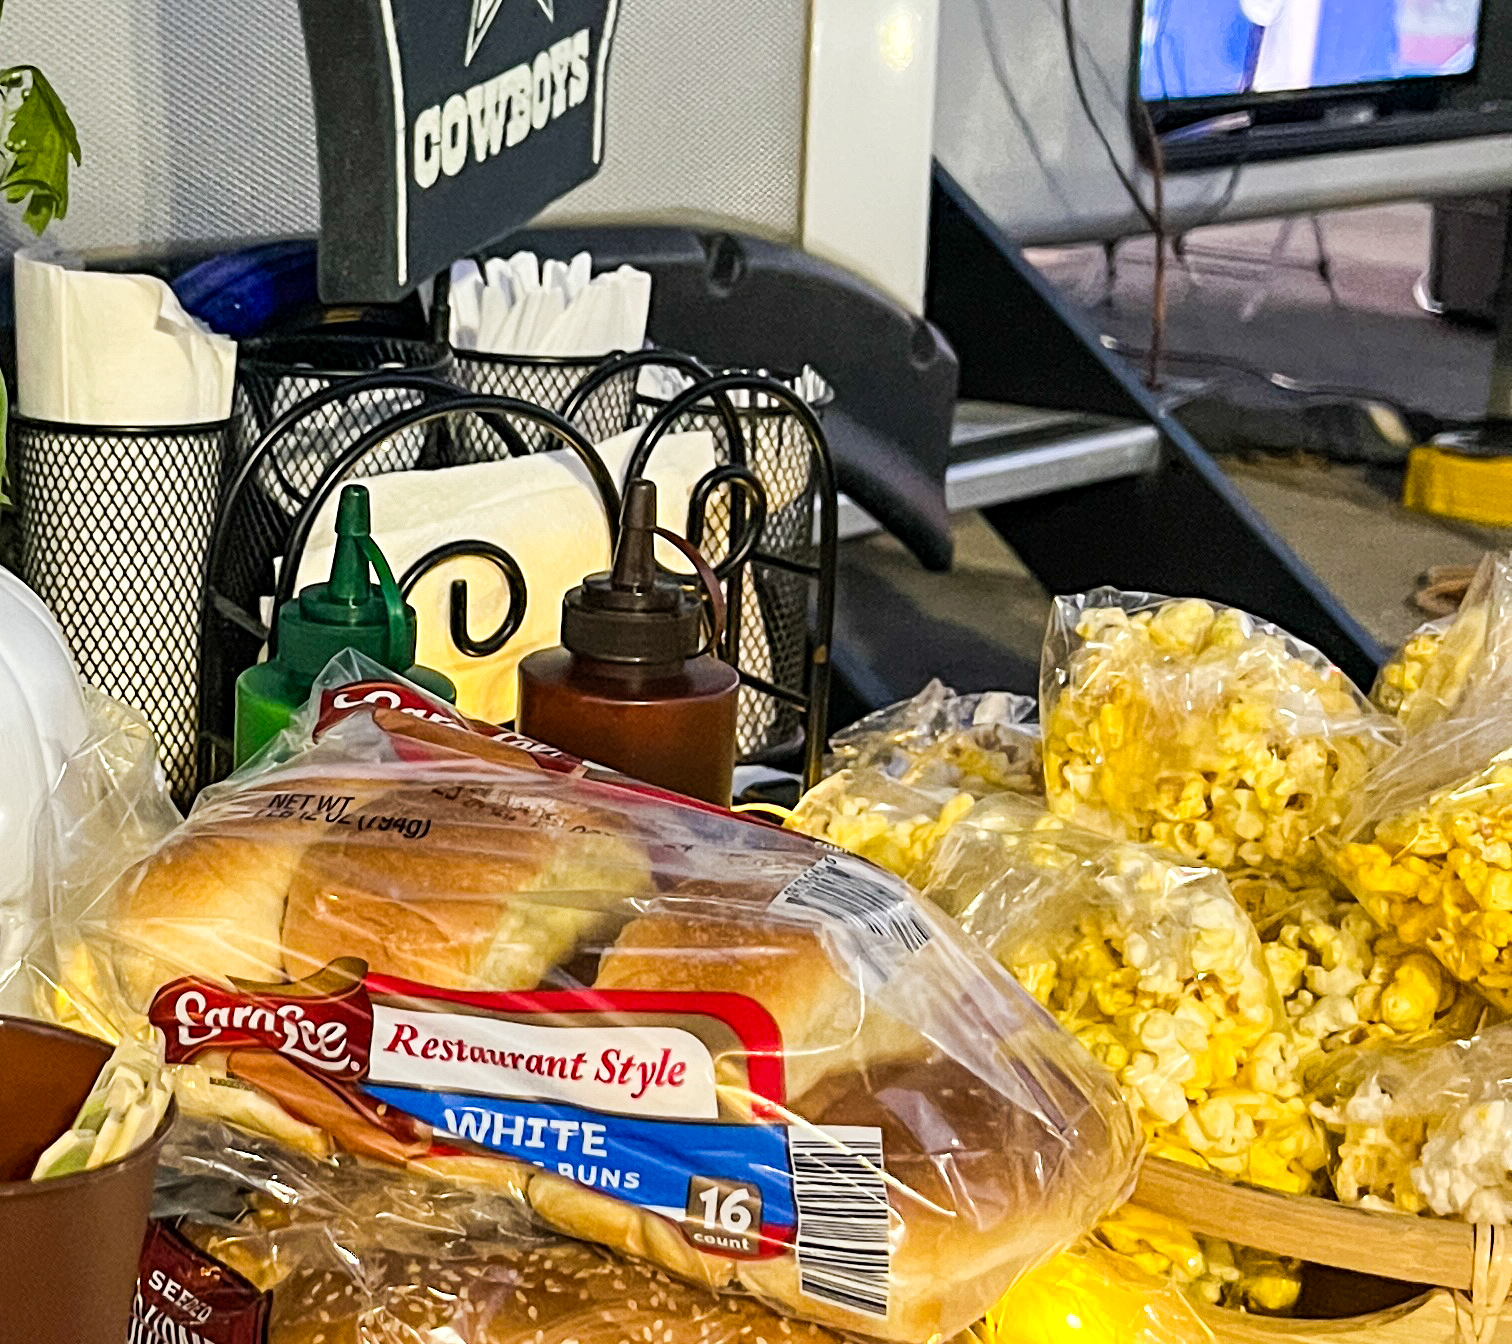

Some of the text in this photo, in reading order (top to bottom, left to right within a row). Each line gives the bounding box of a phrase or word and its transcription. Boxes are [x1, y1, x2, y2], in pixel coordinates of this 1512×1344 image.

[414, 28, 589, 189] COWBOYS
[268, 794, 316, 811] NET
[317, 794, 356, 816] WT
[174, 990, 352, 1071] Sara Lee
[383, 1023, 688, 1099] Restaurant Style
[444, 1108, 608, 1158] WHITE
[698, 1186, 752, 1234] 16
[693, 1232, 751, 1252] count
